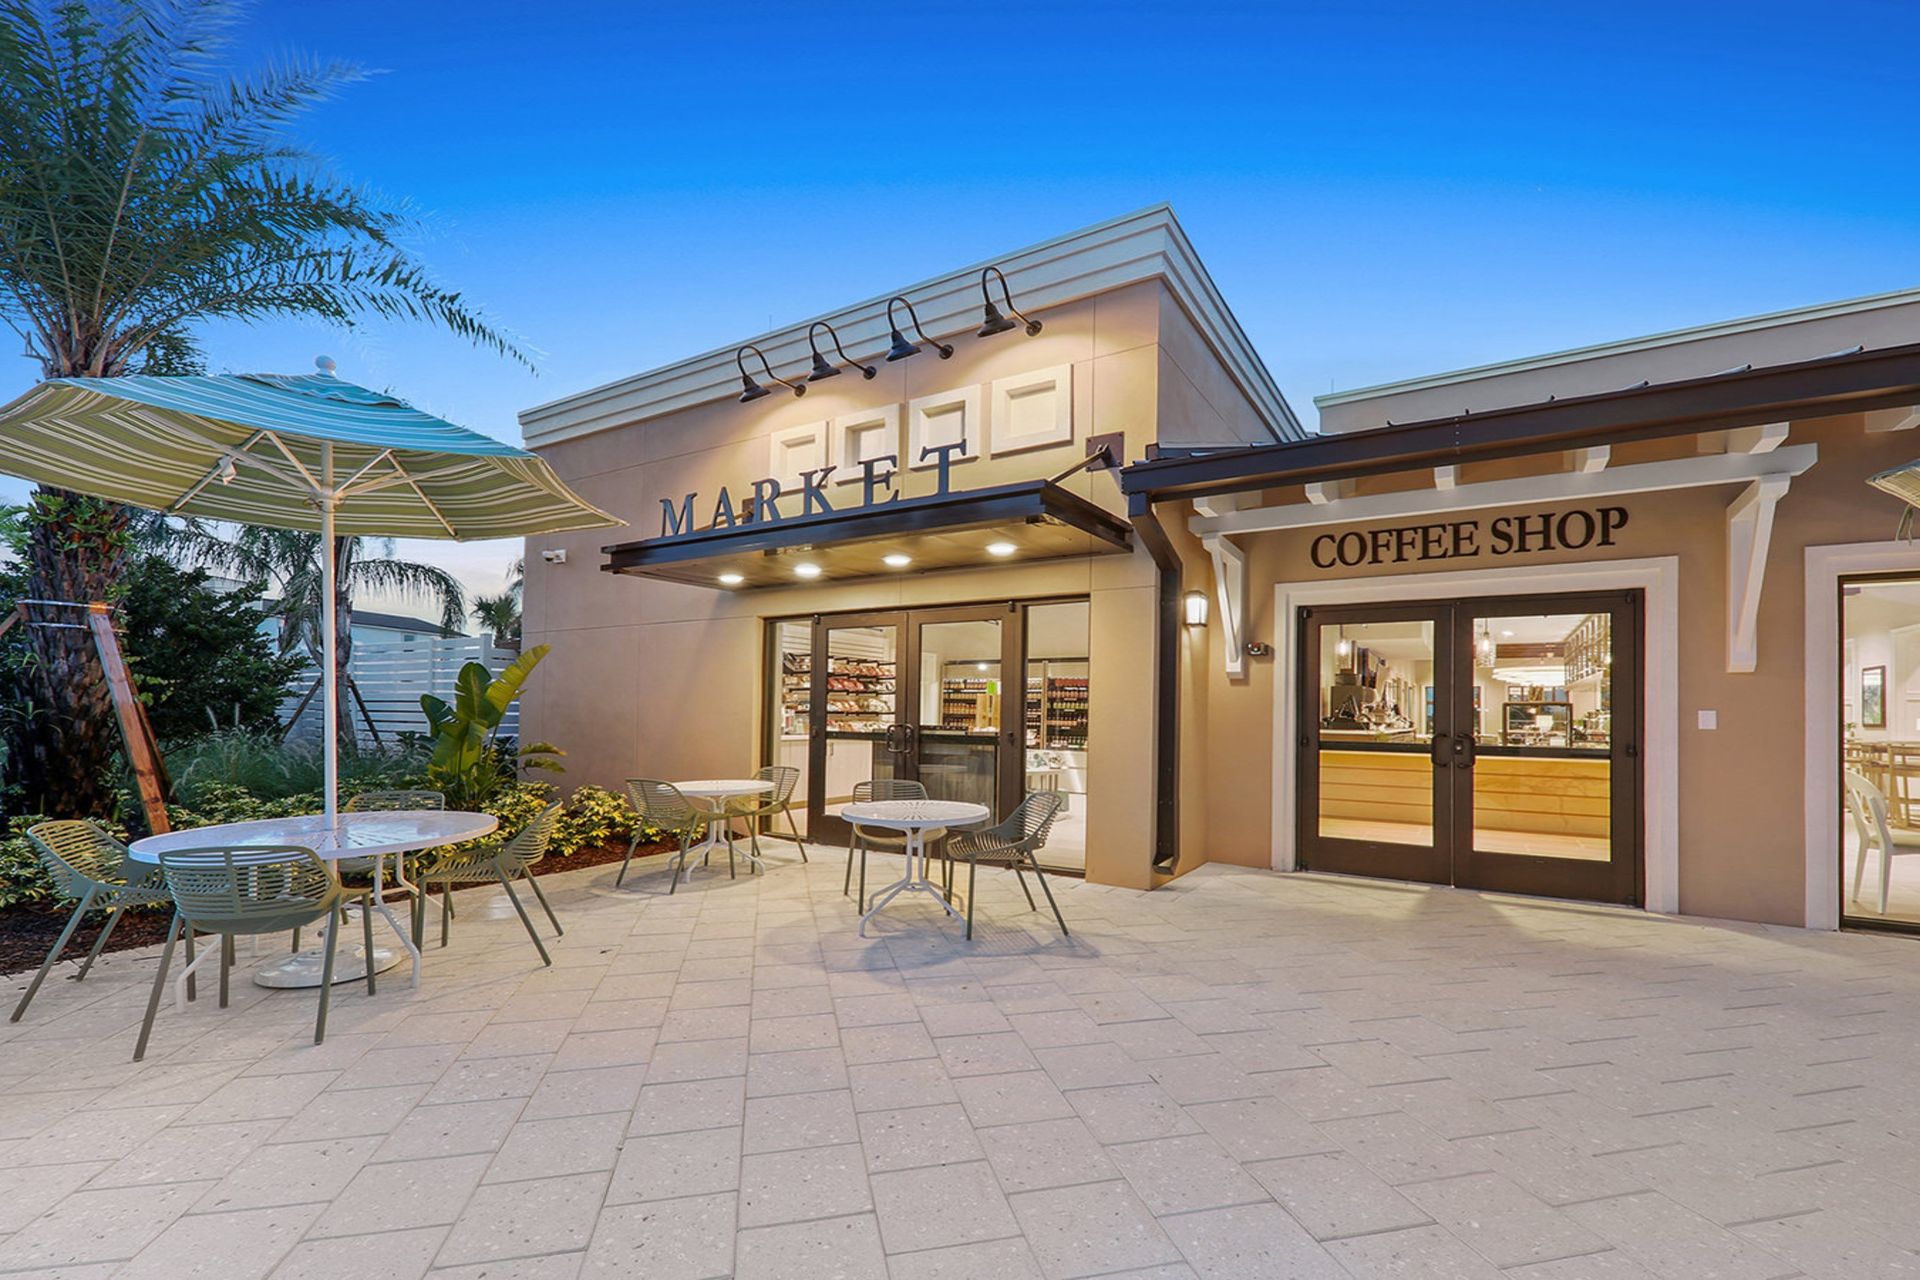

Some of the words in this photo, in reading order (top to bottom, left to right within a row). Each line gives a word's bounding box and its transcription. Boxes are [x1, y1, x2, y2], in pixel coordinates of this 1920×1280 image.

[660, 438, 967, 536] MARKET
[1310, 520, 1480, 569] COFFEE
[1490, 506, 1629, 555] SHOP
